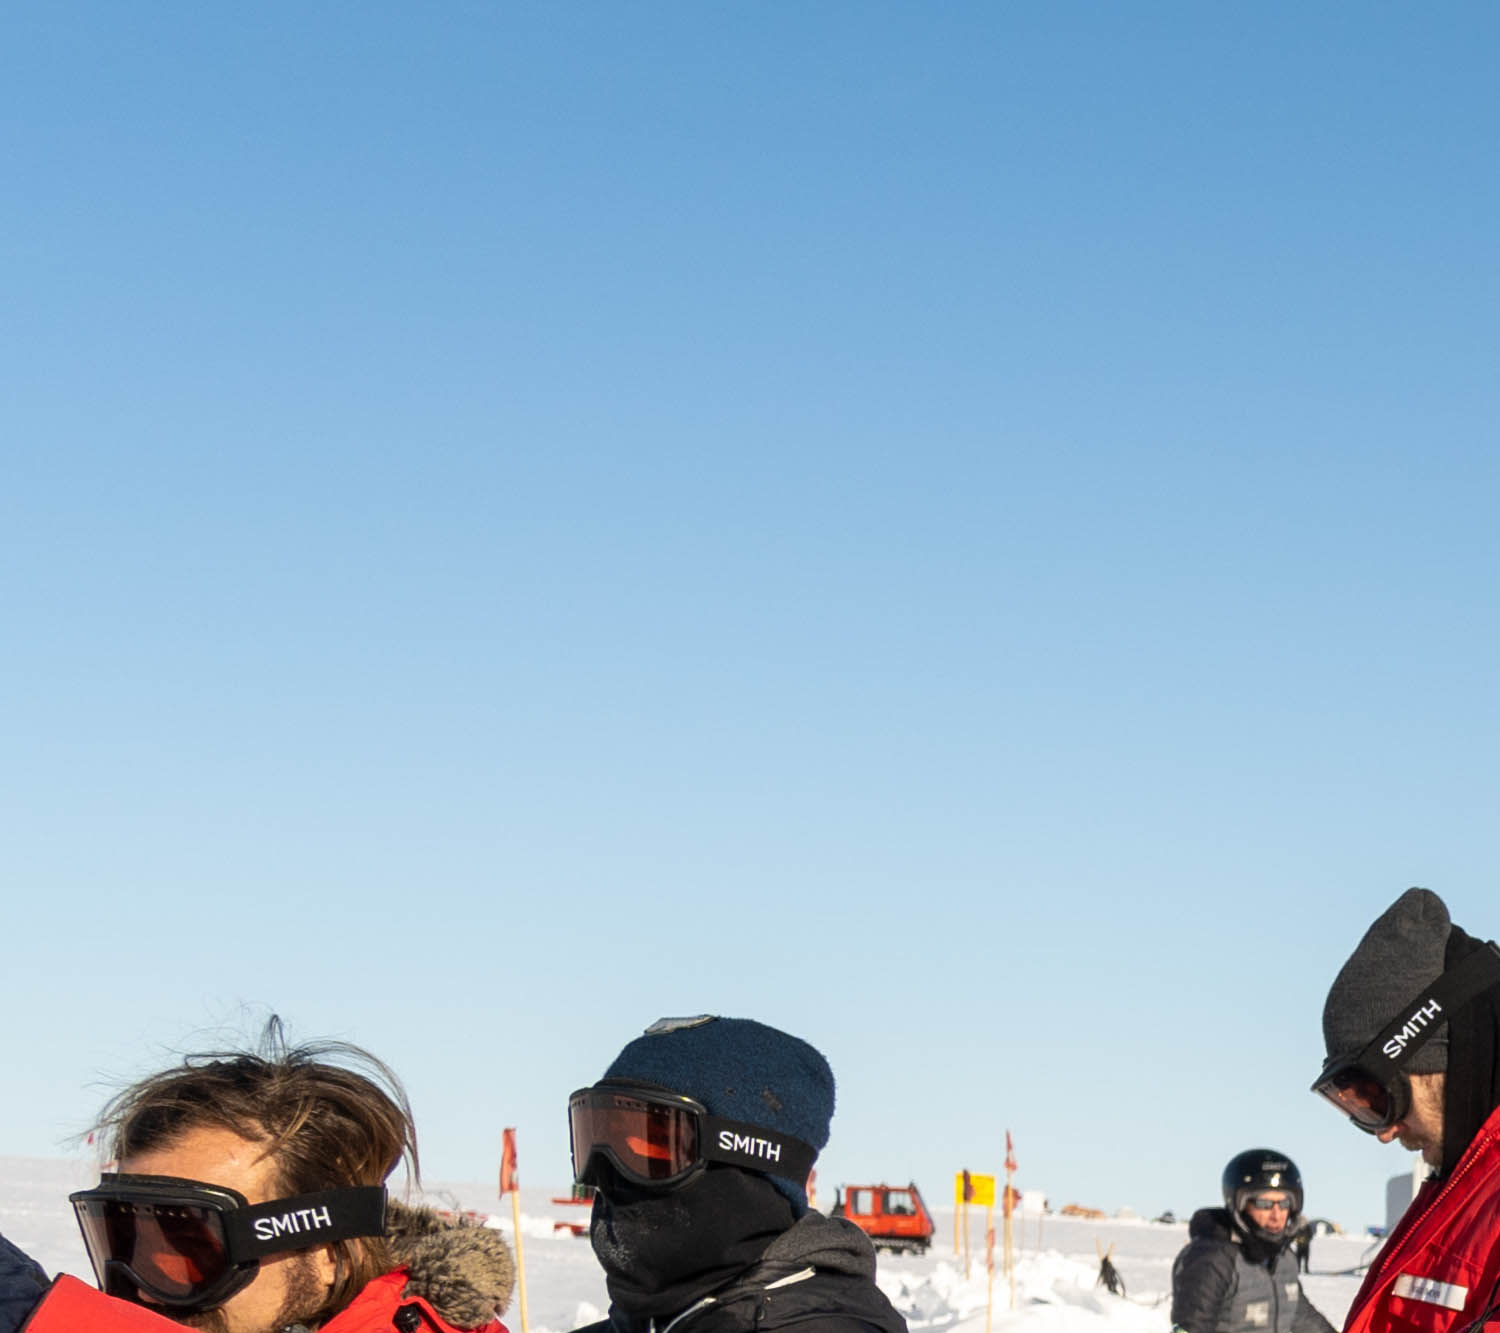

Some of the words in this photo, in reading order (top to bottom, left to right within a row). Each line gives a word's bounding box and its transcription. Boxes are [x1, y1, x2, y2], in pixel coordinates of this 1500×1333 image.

[1382, 999, 1442, 1059] SMITH
[718, 1131, 781, 1162] SMITH
[254, 1206, 332, 1240] SMITH
